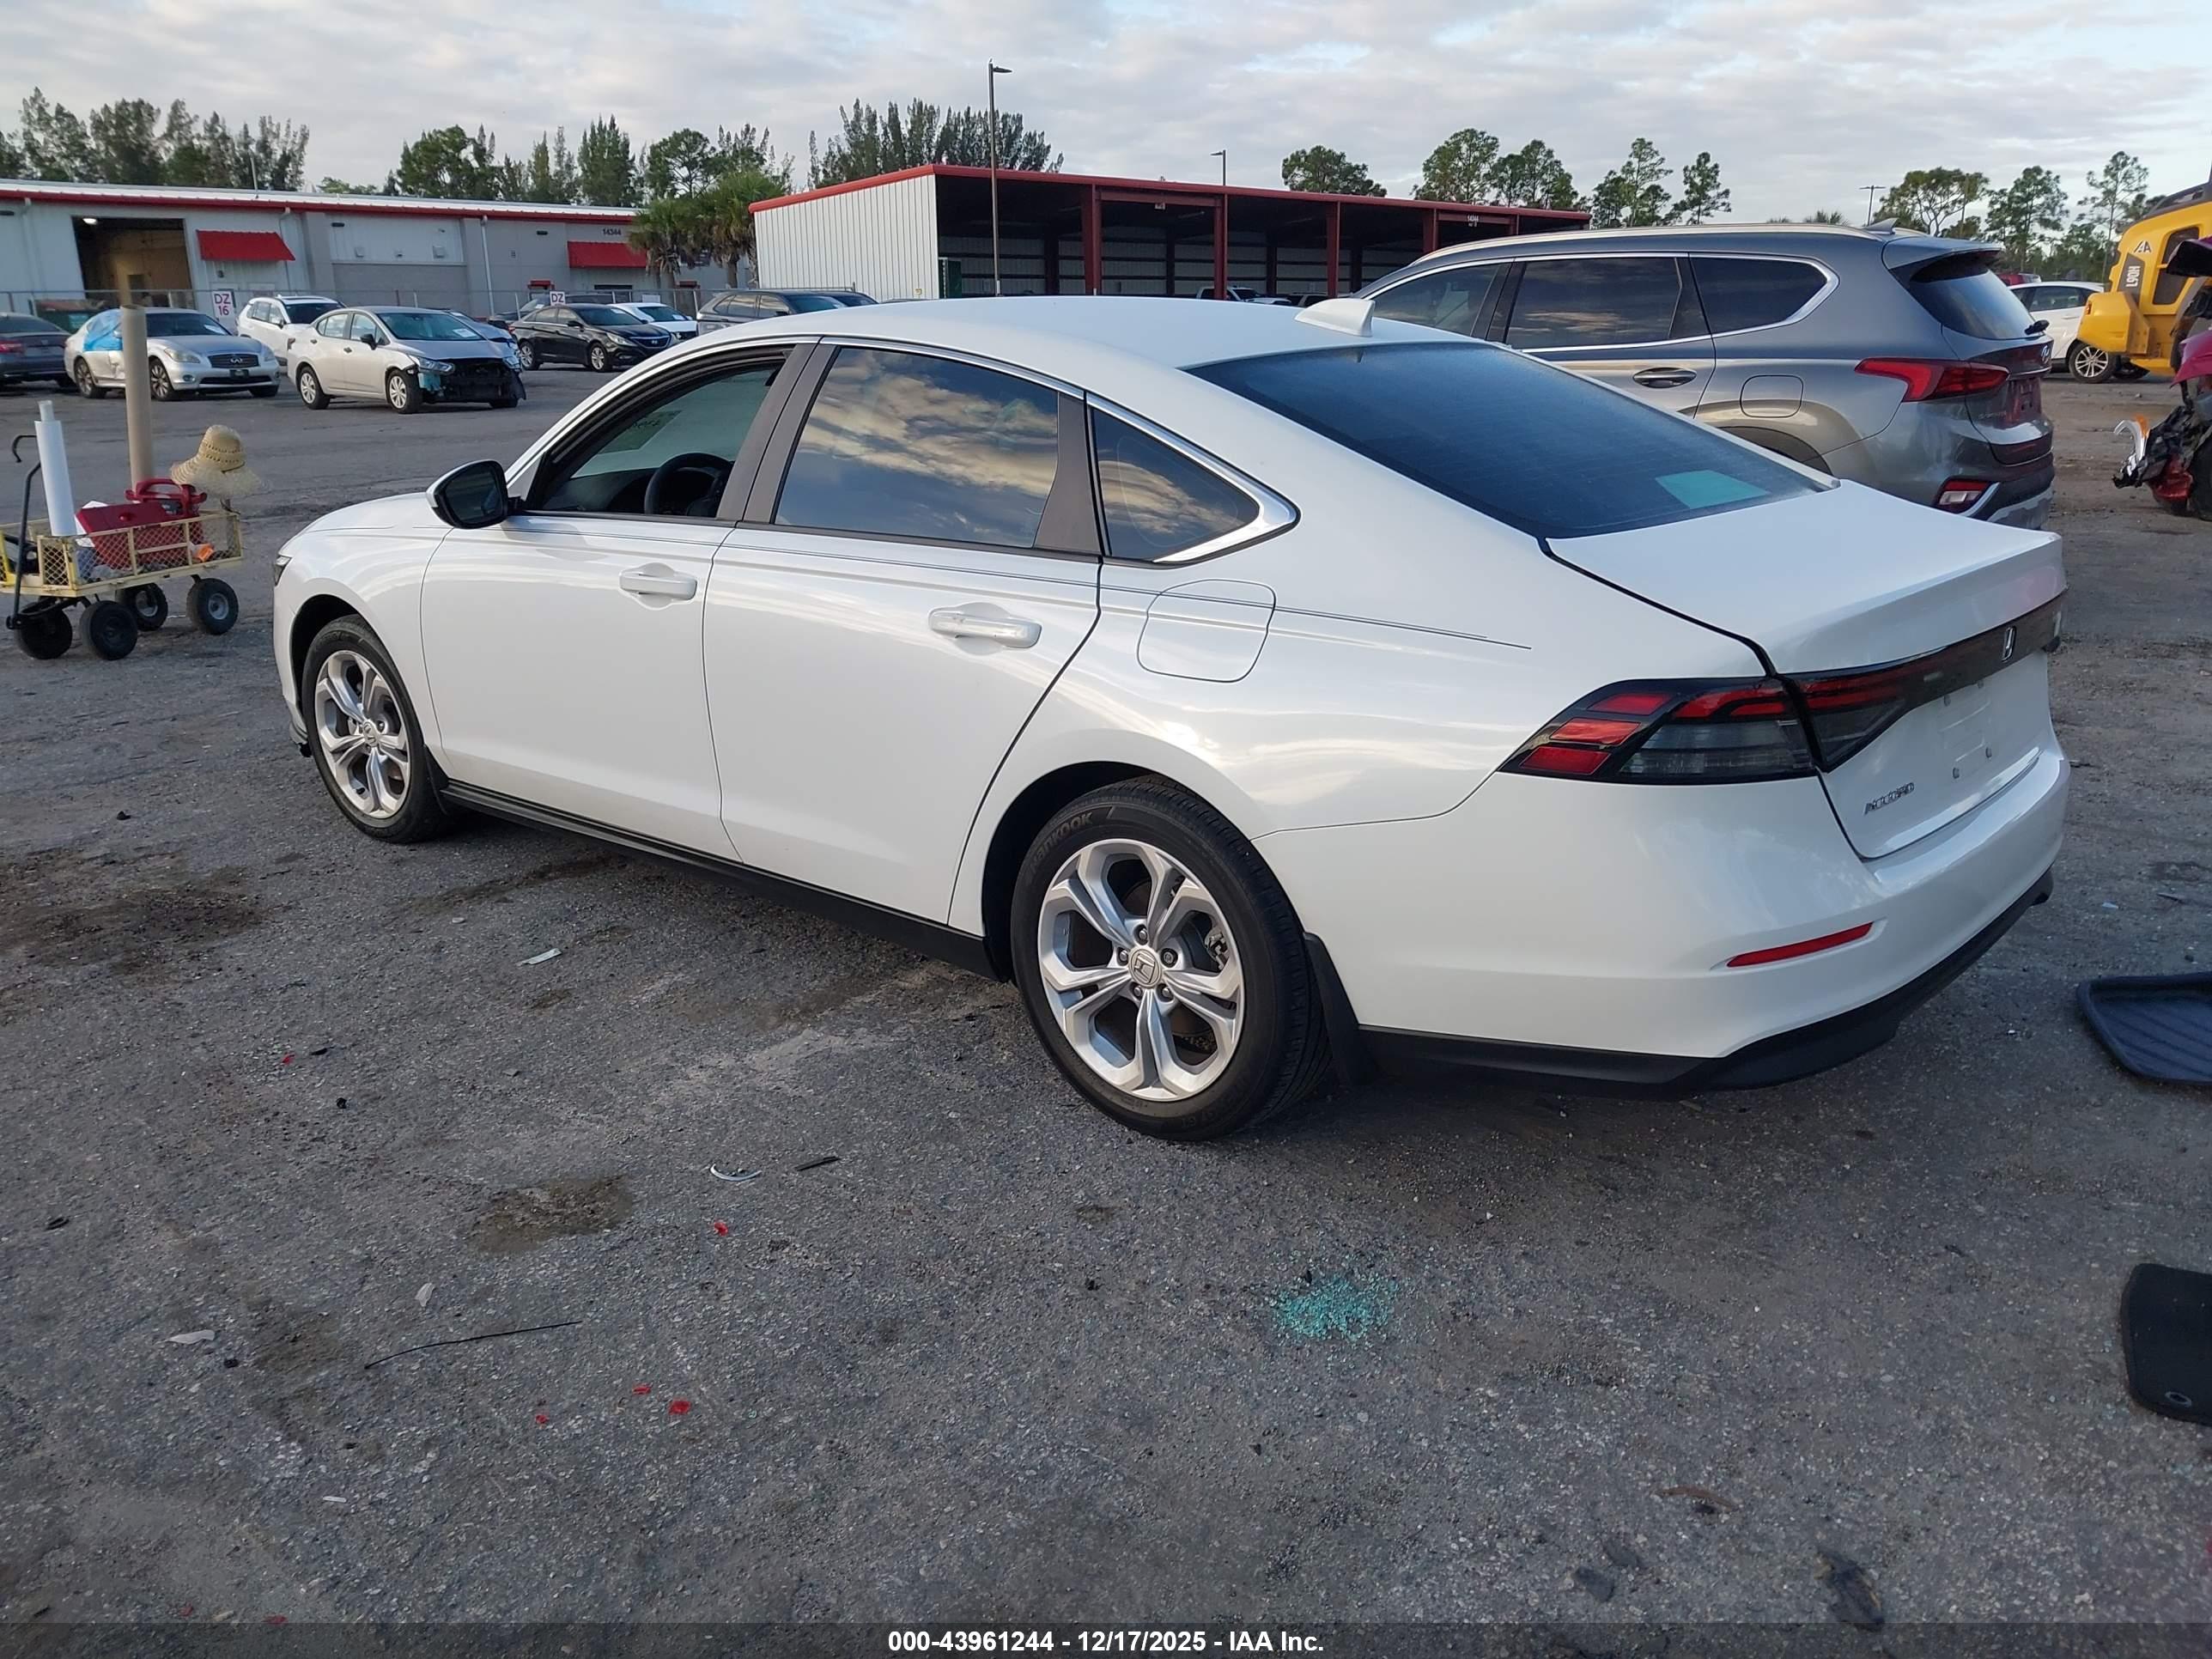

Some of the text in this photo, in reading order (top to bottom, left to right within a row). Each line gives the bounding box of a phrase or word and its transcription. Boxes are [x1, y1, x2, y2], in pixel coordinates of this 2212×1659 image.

[2125, 265, 2141, 288] L90H
[214, 293, 231, 304] DZ
[550, 293, 564, 303] DZ
[218, 305, 229, 316] 16
